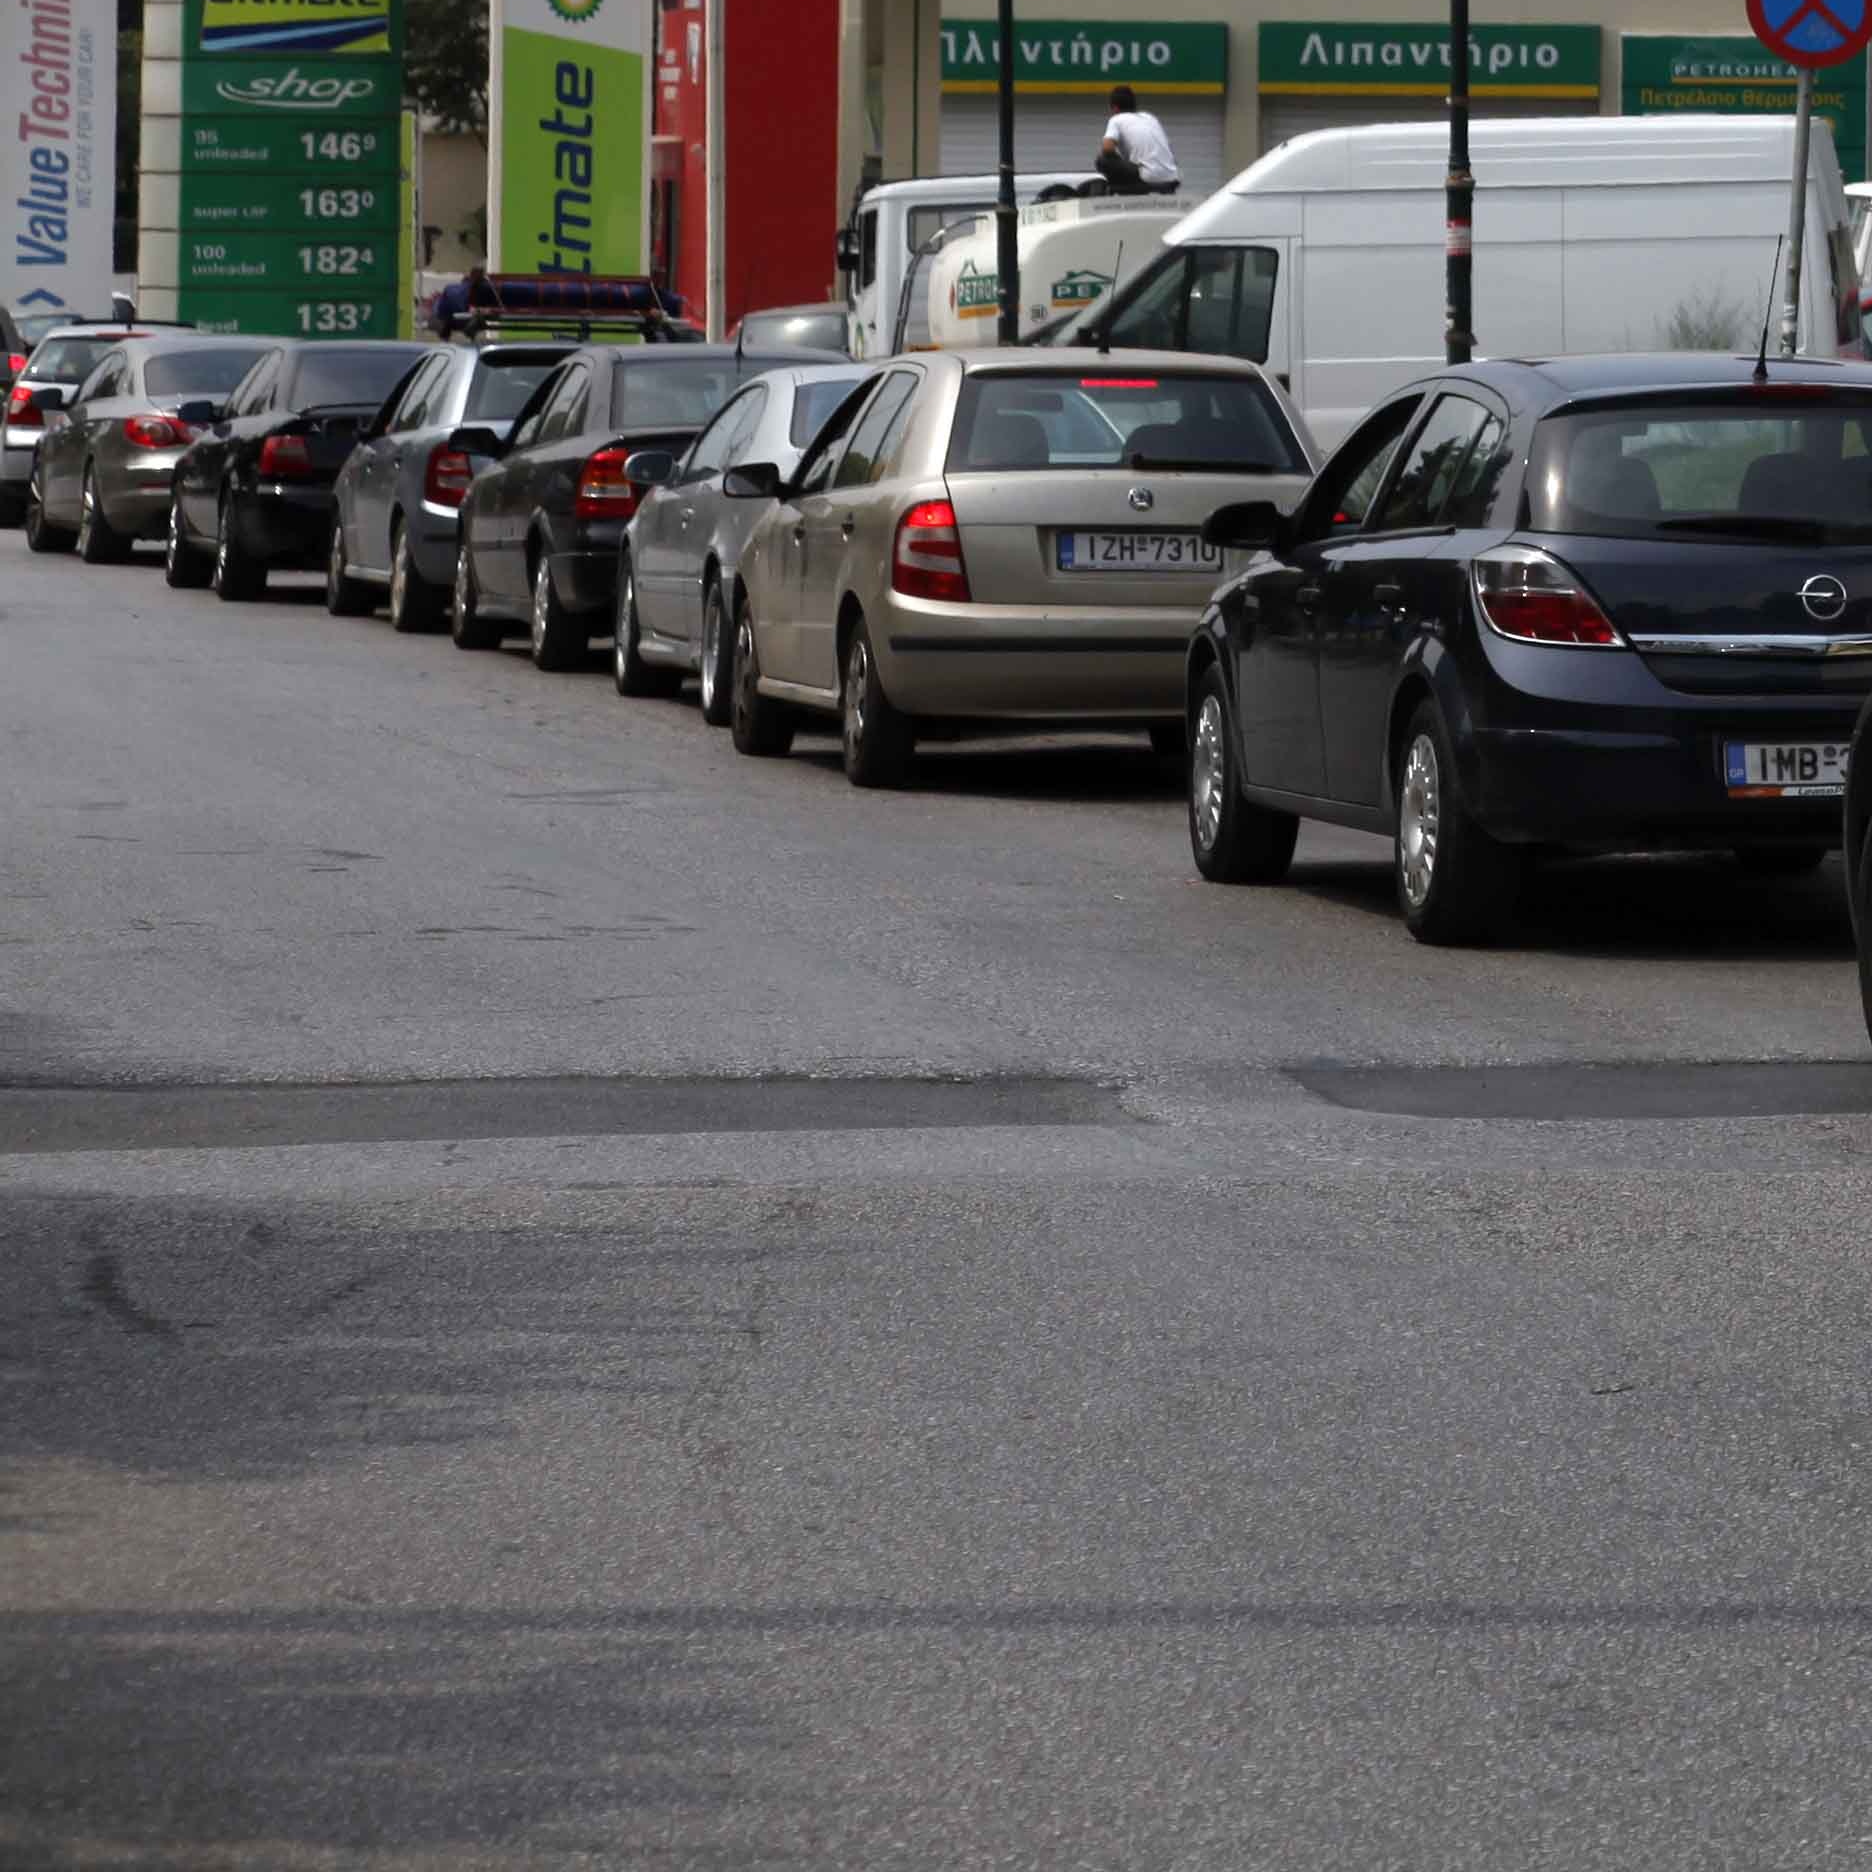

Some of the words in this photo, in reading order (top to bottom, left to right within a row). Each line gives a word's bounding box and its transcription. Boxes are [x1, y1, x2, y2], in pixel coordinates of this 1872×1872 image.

[1675, 63, 1799, 76] PETROHEA
[218, 68, 375, 108] shop
[1743, 89, 1846, 110] Θέρμσης
[193, 245, 226, 259] 100
